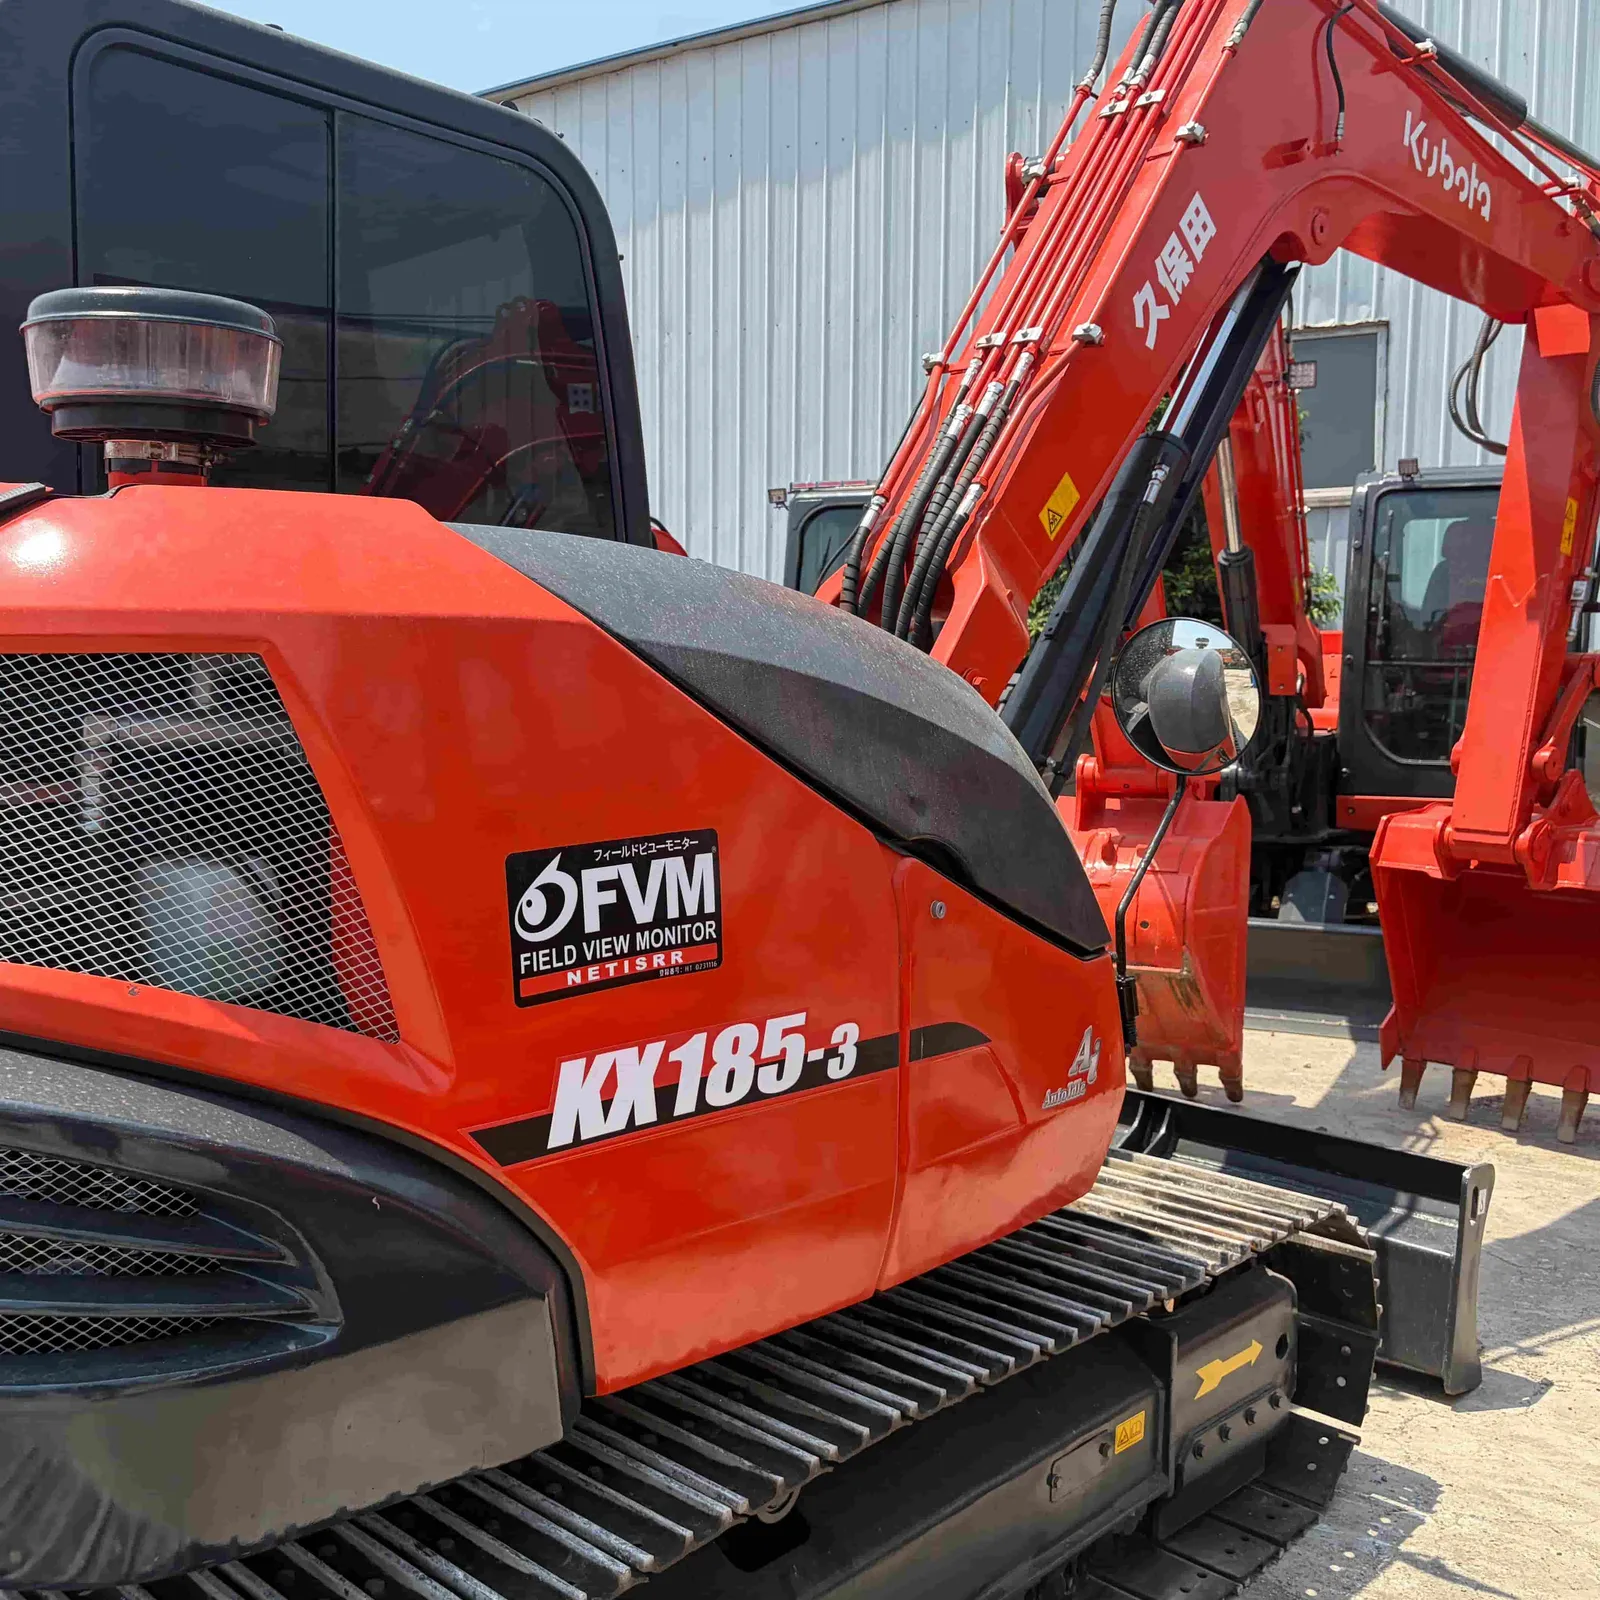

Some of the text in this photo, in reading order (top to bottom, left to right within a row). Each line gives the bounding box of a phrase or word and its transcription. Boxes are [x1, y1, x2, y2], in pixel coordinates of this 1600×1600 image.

[1403, 110, 1491, 222] Kubota
[1133, 191, 1217, 351] 久保田
[581, 852, 716, 934] FVM
[520, 920, 717, 974] FIELD VIEW MONITOR
[567, 951, 684, 986] NETISRR
[547, 1011, 860, 1149] KX185-3
